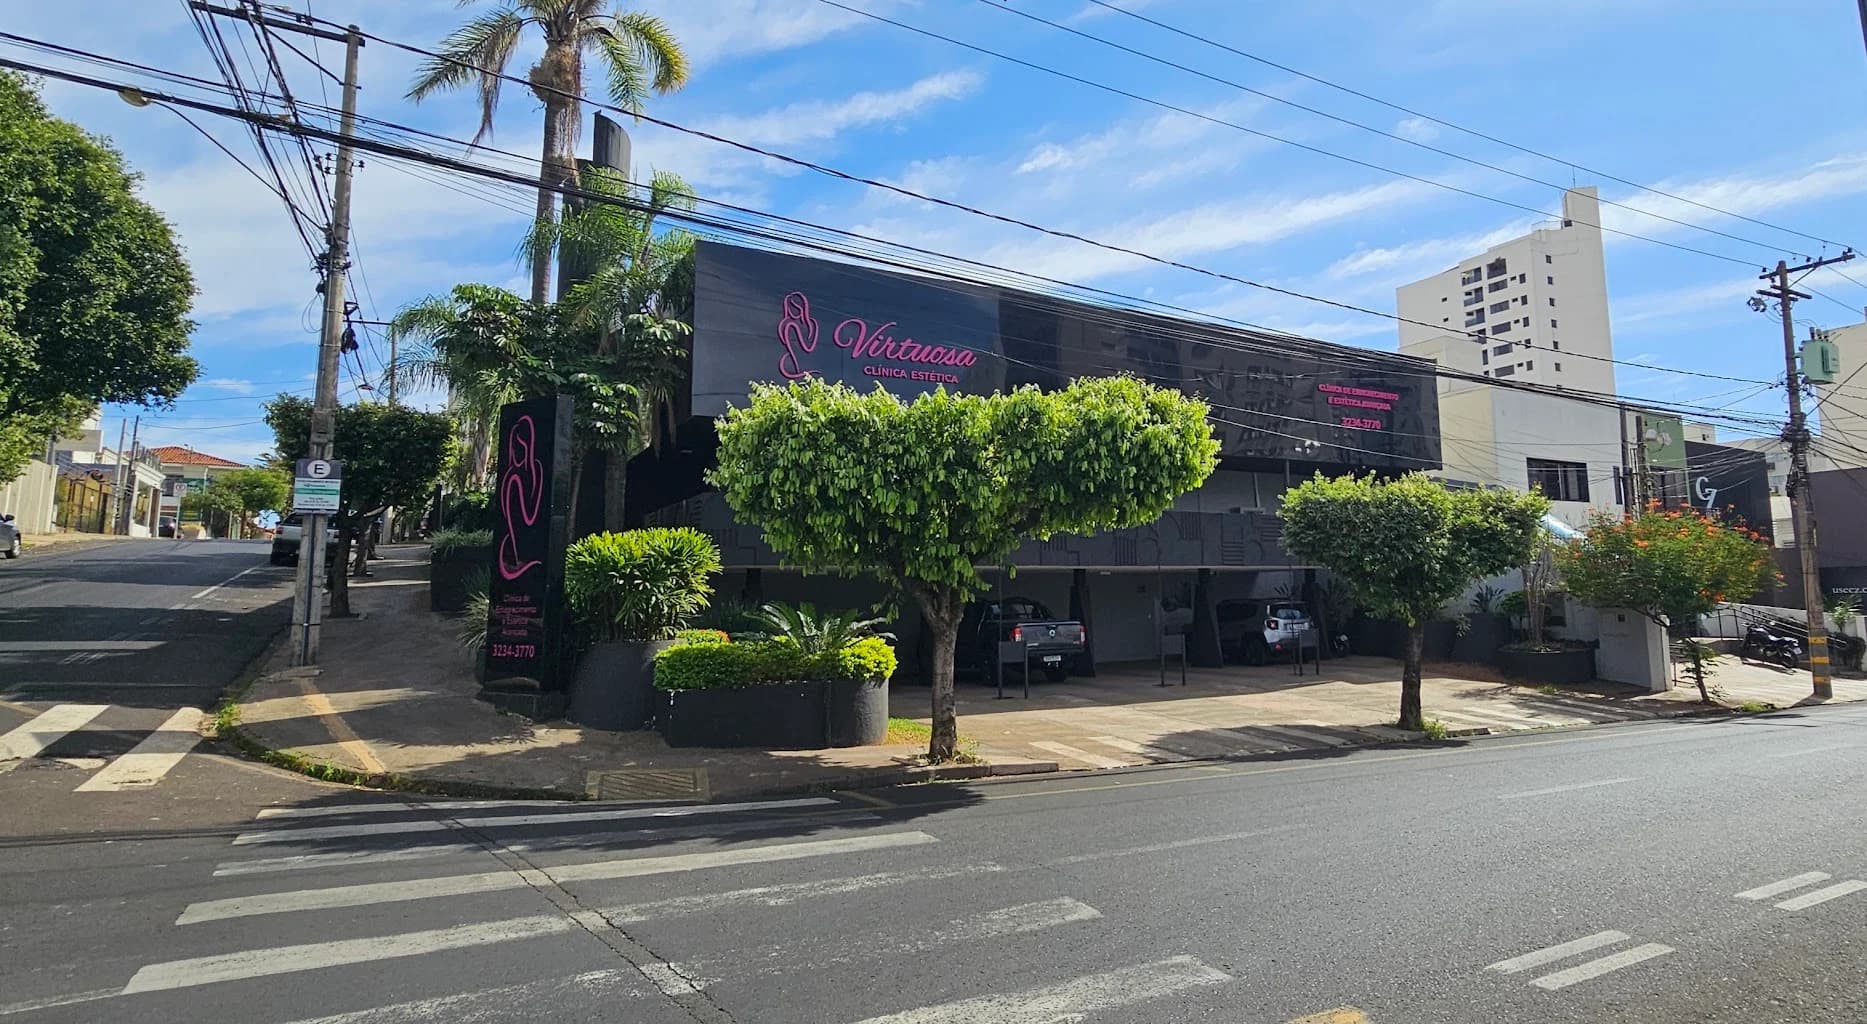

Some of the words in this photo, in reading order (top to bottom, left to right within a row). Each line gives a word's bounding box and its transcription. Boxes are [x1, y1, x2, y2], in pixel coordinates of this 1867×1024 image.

[833, 318, 977, 367] Virtuosa
[864, 364, 907, 378] CLÍNICA
[911, 370, 959, 384] ESTÉTICA
[1342, 417, 1381, 429] 3234-3770
[314, 464, 325, 475] E
[492, 644, 535, 658] 3234-3770
